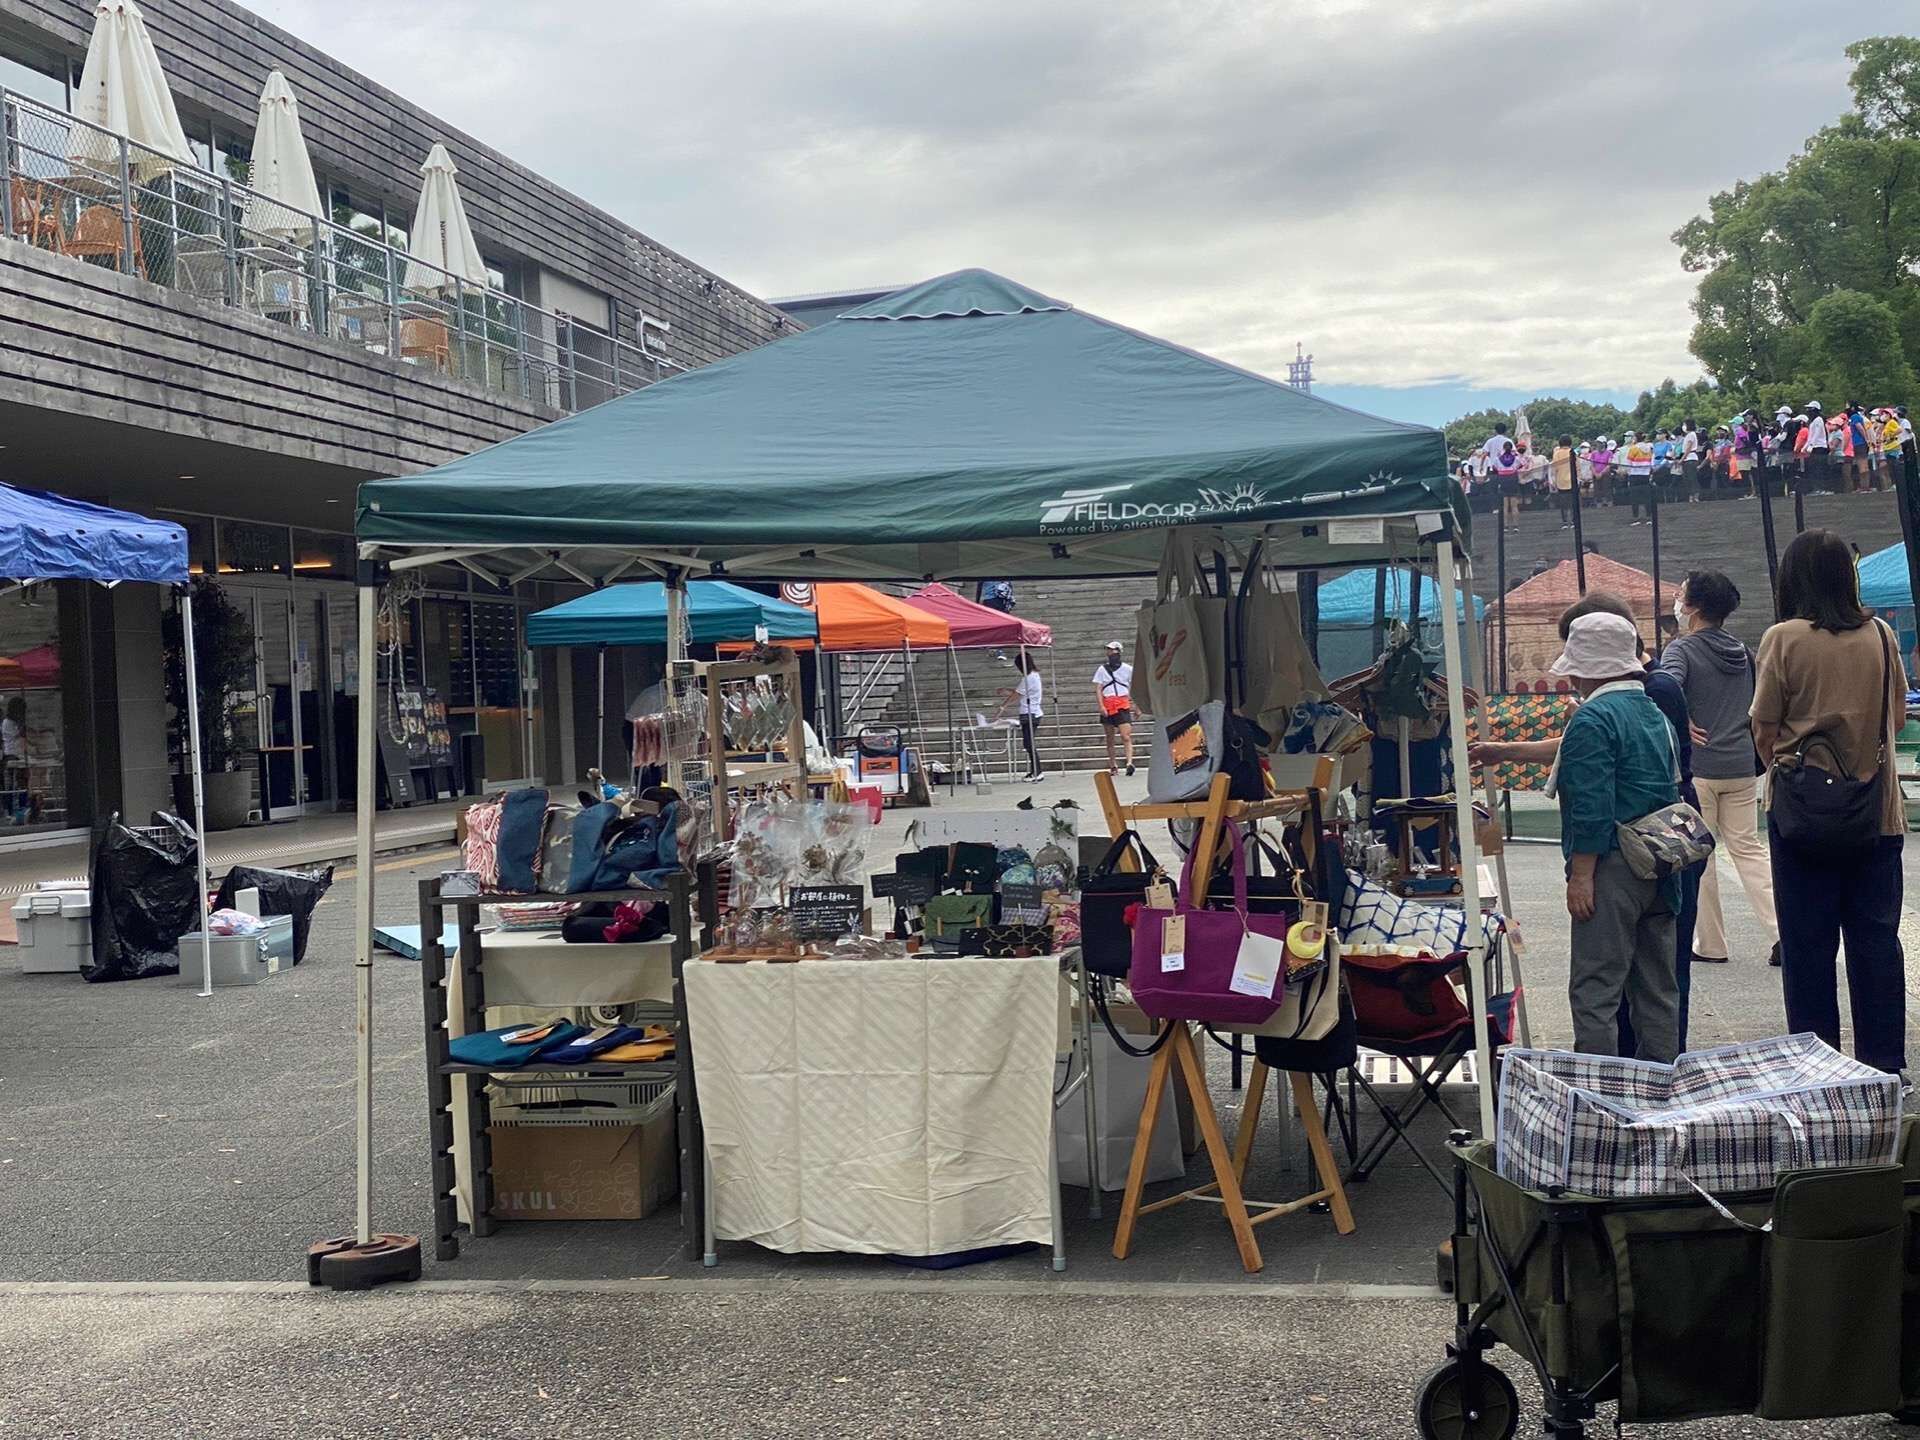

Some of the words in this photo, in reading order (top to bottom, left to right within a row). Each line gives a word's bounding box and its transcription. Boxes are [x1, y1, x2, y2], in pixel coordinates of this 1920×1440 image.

[1039, 522, 1096, 536] Powered
[1101, 521, 1117, 532] by
[500, 1191, 557, 1211] SKUL
